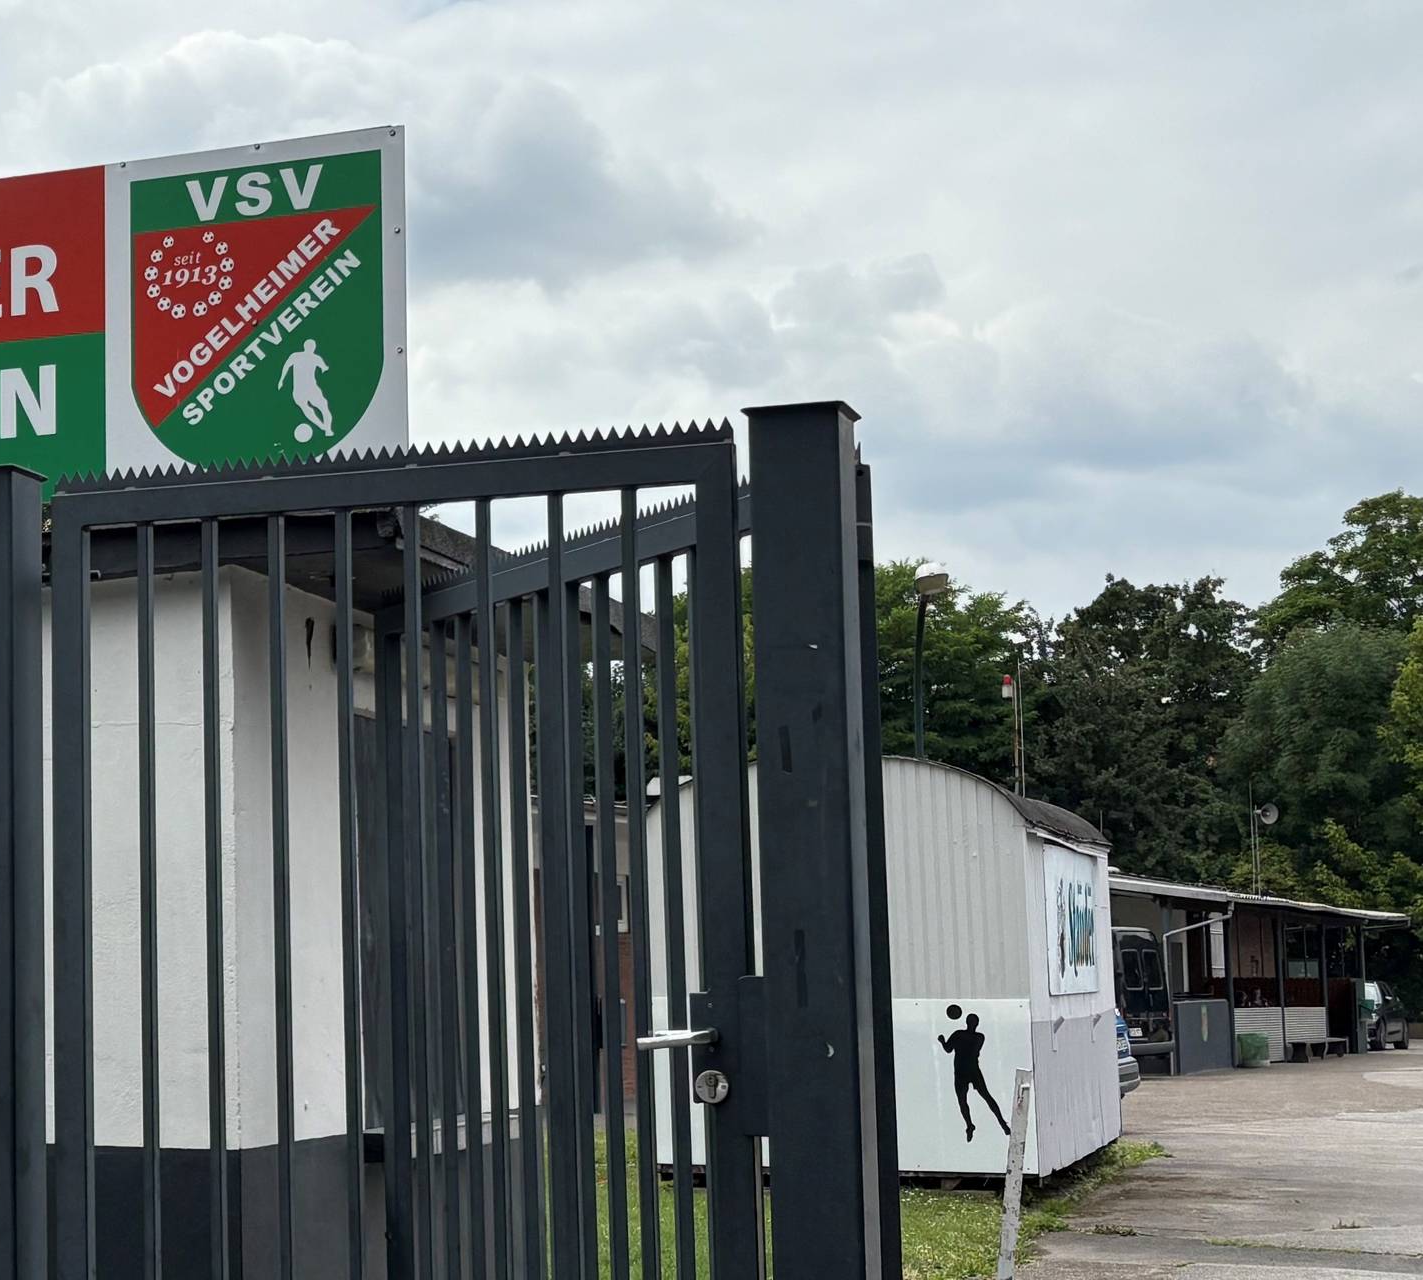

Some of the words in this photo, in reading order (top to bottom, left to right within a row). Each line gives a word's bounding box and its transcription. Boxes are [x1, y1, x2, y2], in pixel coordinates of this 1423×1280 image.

[185, 163, 324, 222] VSV
[161, 265, 218, 288] 1913
[173, 251, 201, 266] seit
[153, 218, 341, 399] VOGELHEIMER
[182, 248, 361, 425] SPORTVEREIN
